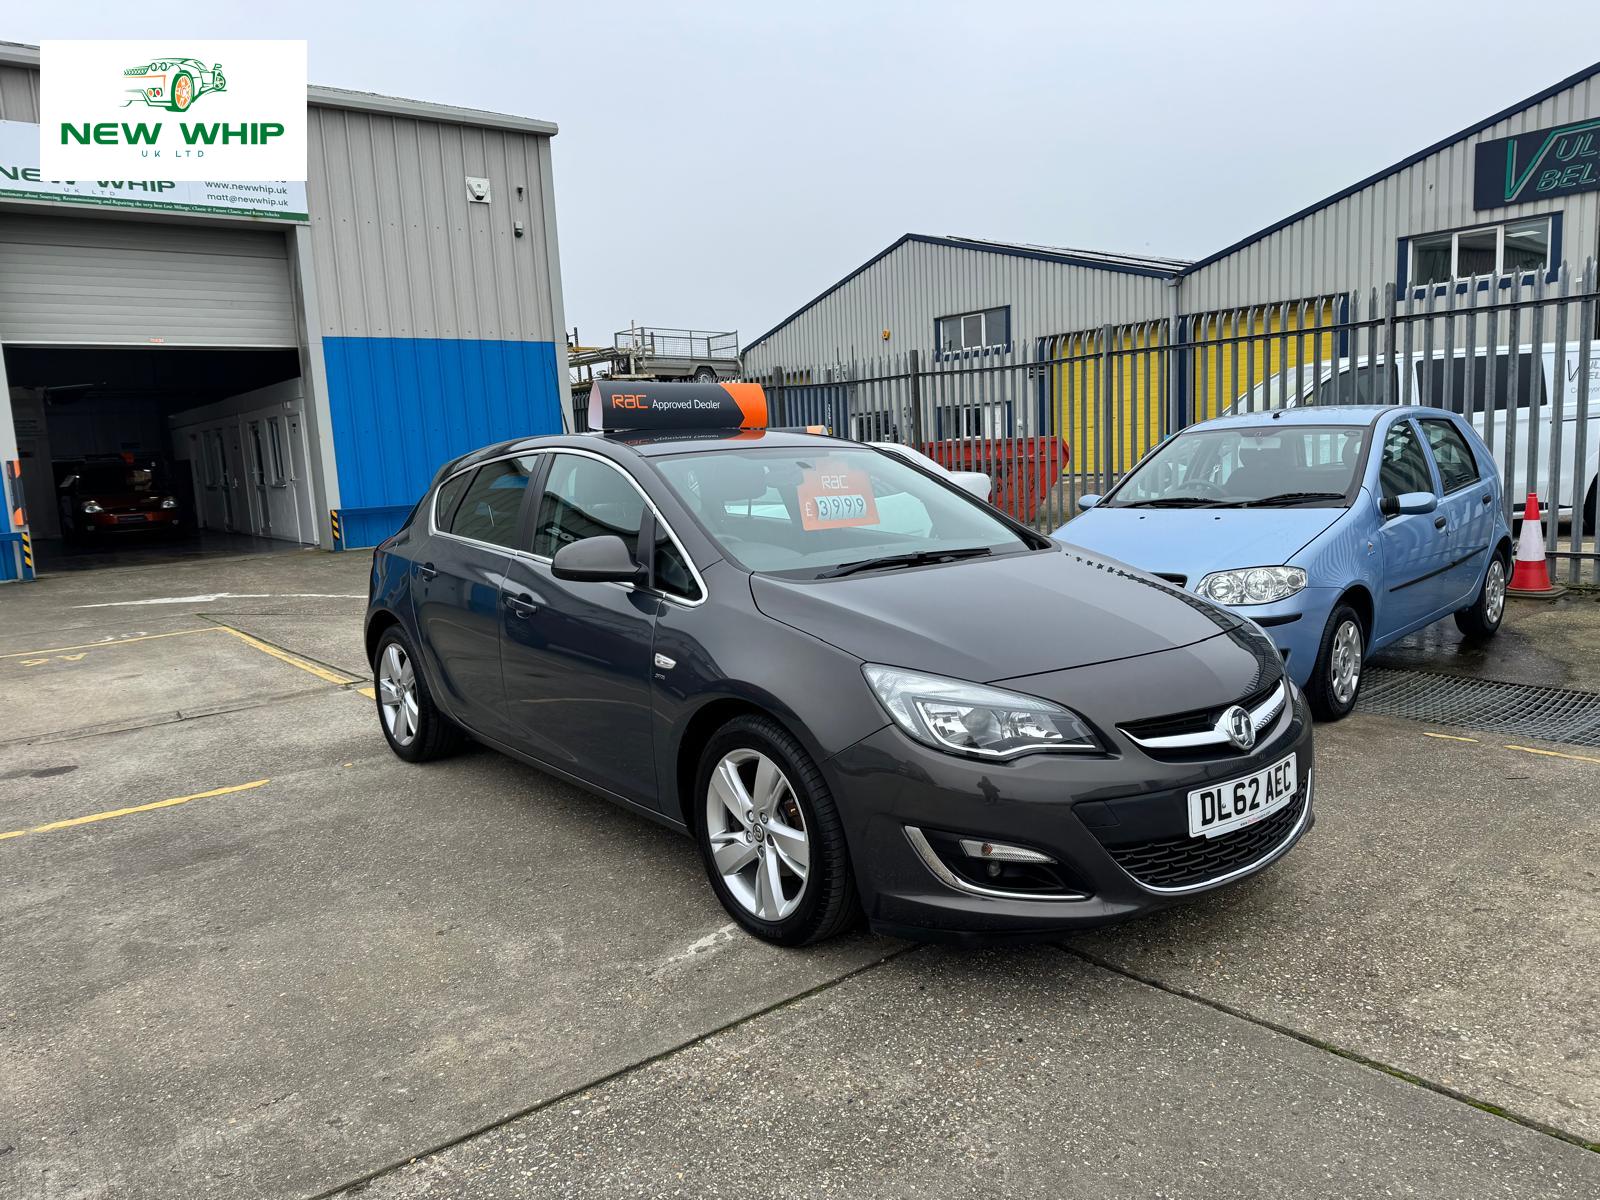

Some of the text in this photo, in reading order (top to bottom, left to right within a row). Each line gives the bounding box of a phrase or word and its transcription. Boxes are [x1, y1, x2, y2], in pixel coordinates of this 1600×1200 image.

[205, 181, 288, 195] www.newwhip.uk
[206, 193, 289, 207] matt@newwhip.uk
[652, 399, 692, 412] Approved
[694, 399, 721, 409] Dealer
[1199, 760, 1292, 827] DL62 AEC
